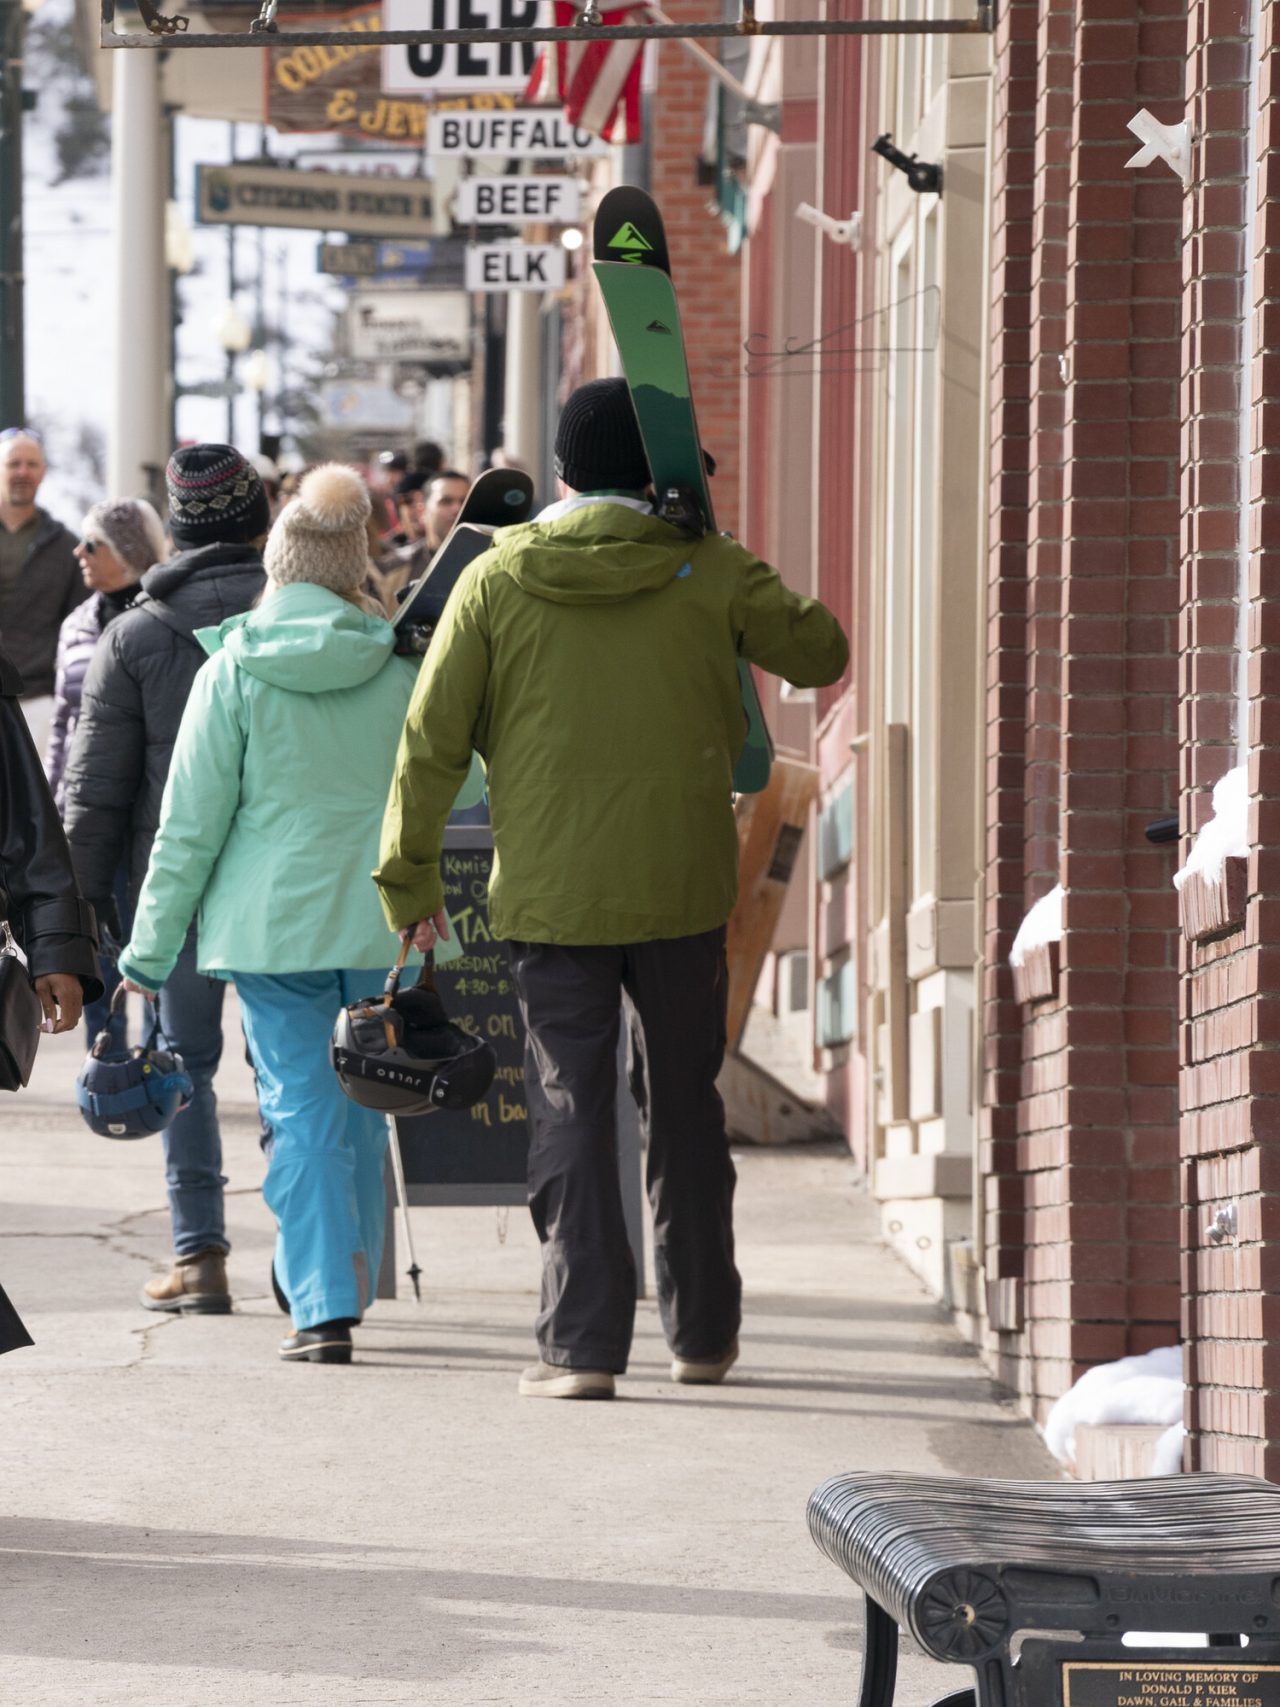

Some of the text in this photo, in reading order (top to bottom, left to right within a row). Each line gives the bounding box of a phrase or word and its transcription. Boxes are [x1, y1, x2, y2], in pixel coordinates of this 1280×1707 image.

[407, 0, 538, 78] JER
[442, 120, 593, 149] BUFFALO
[476, 184, 562, 215] BEEF
[483, 253, 548, 283] ELK
[1119, 1671, 1259, 1683] IN LOVING MEMORY OF
[1141, 1684, 1237, 1695] DONALD P. KIER
[1117, 1696, 1262, 1707] DAWN, GAIL & FAMILIES
